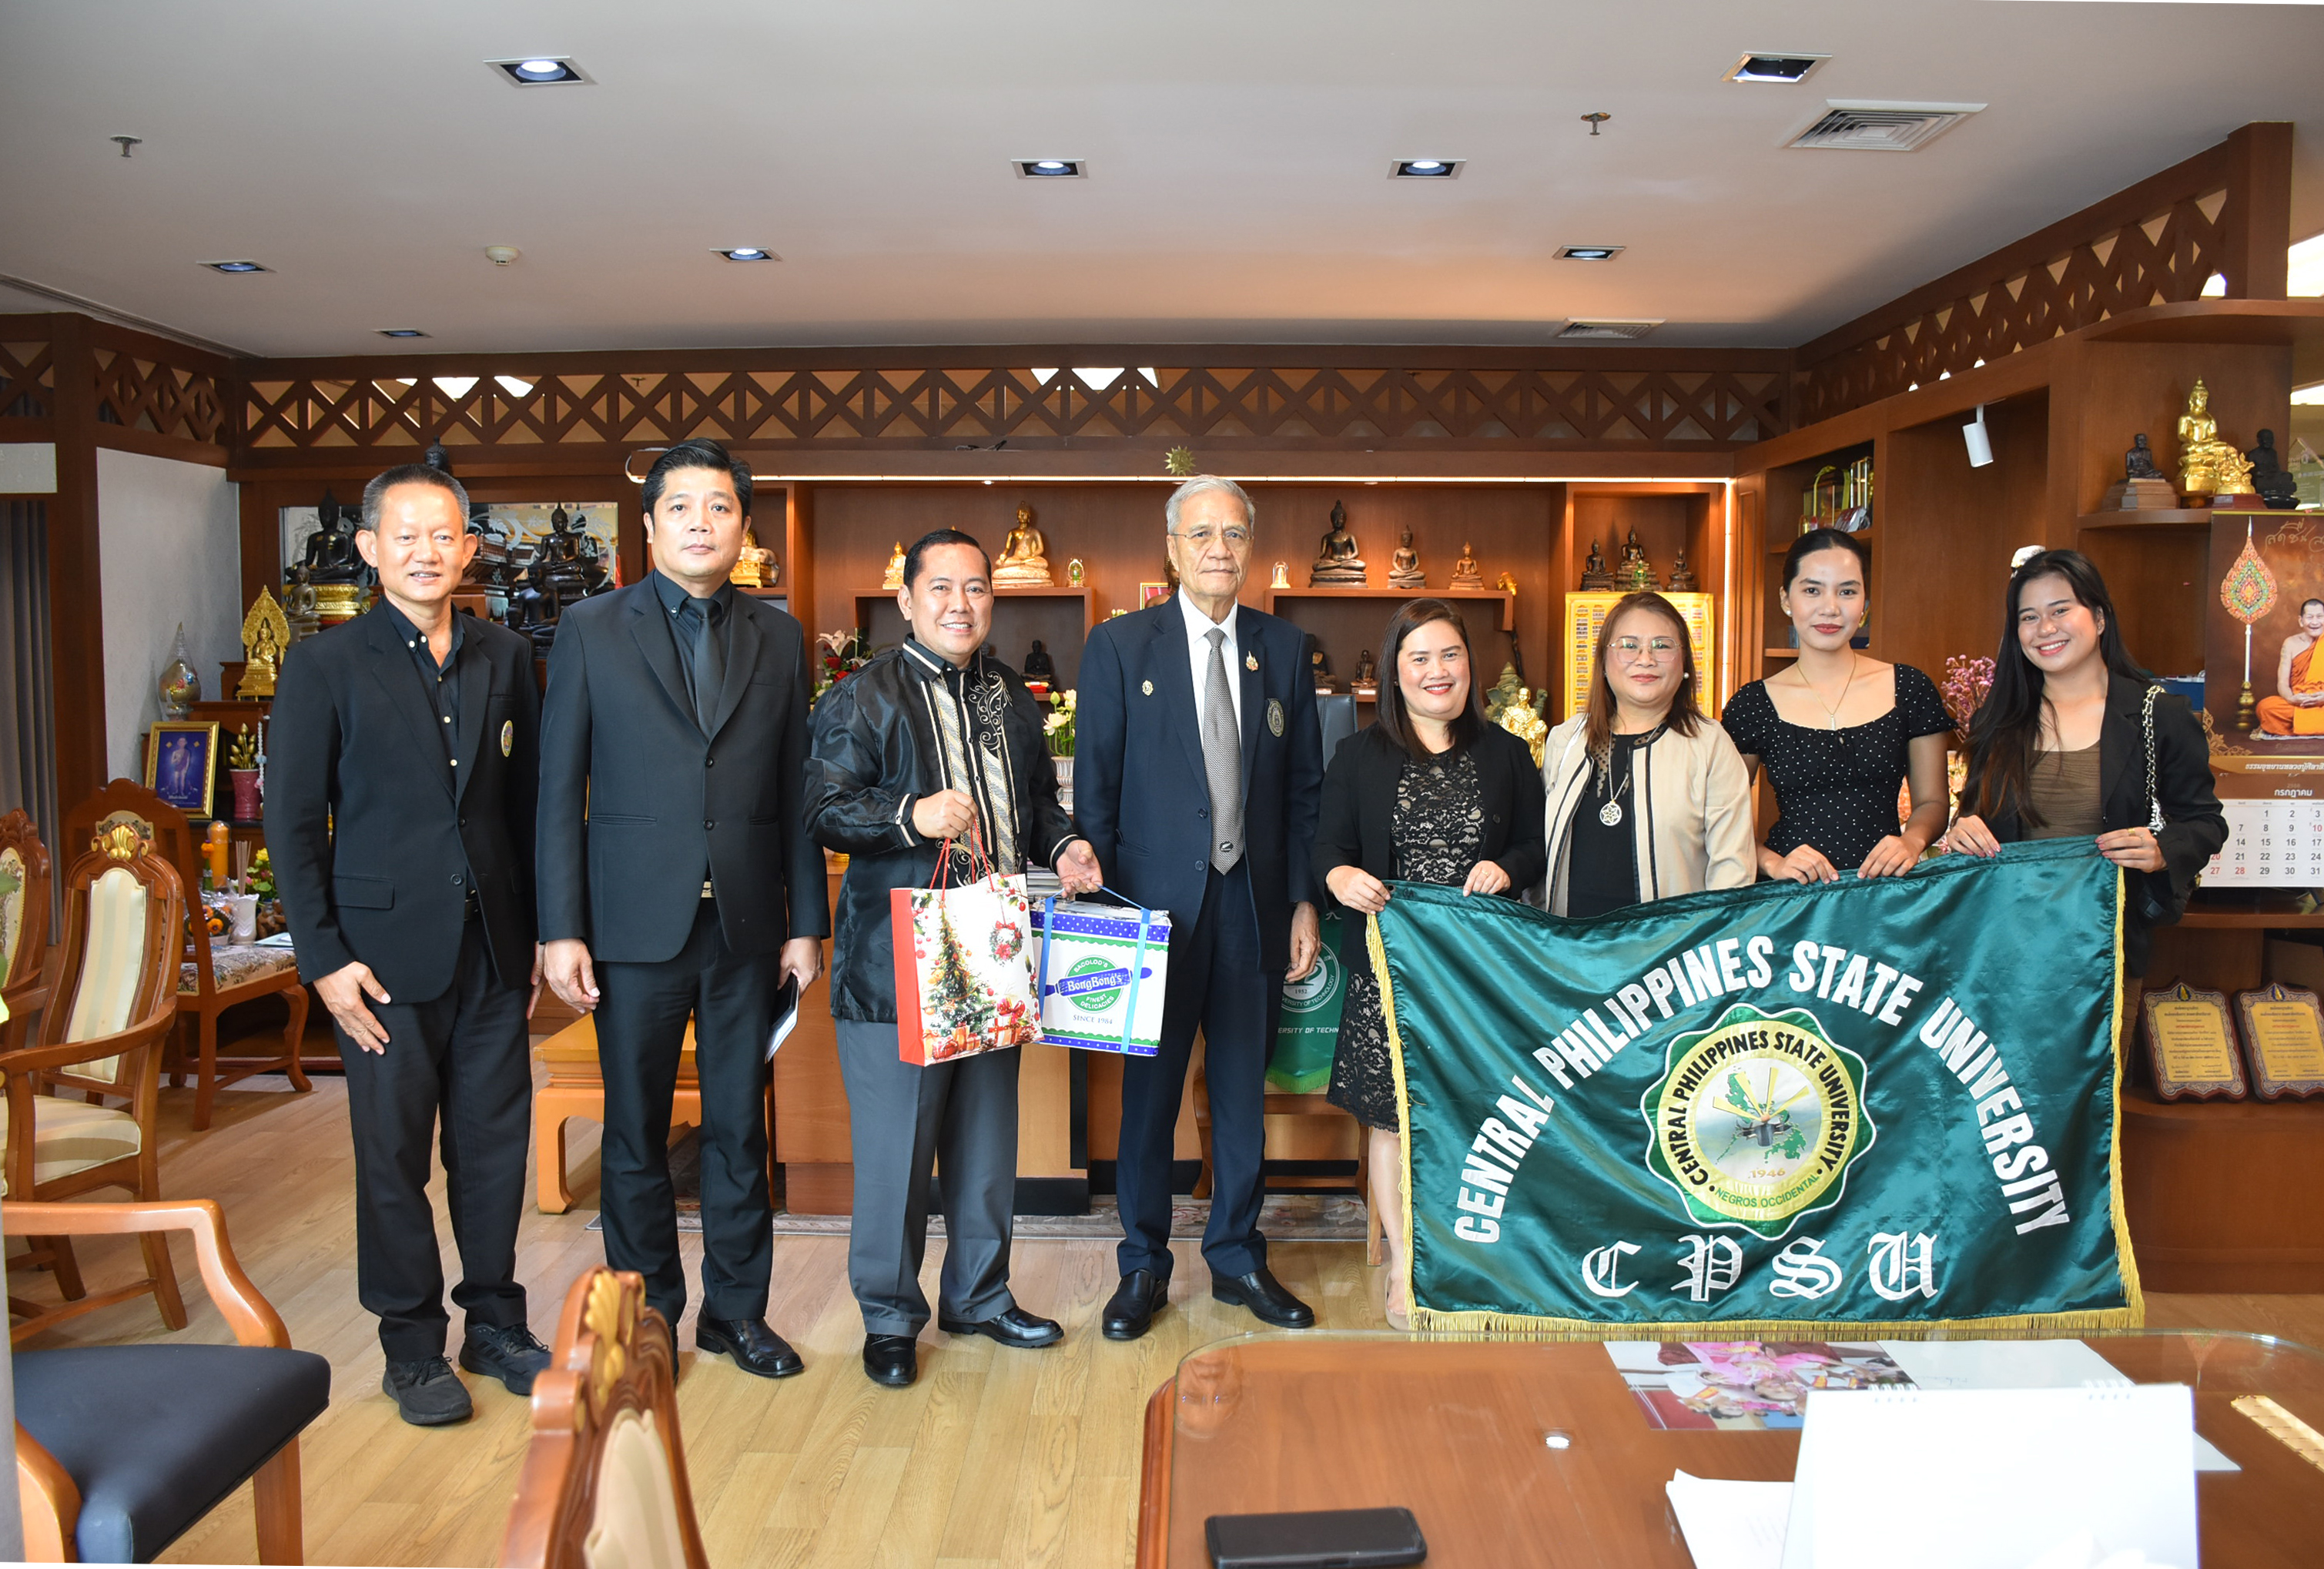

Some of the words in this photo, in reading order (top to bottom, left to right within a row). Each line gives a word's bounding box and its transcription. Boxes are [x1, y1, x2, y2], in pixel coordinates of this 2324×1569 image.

[2274, 789, 2312, 798] กรกฎาคม
[1073, 959, 1108, 973] BACOLOD'S
[1067, 973, 1123, 992] BongBong's
[1311, 975, 1335, 1004] TECHNOLOGY
[1080, 995, 1115, 1009] DELICACIES
[1086, 993, 1107, 1003] FINEST
[1073, 1014, 1094, 1022] SINCE
[1773, 1032, 1827, 1069] STATE
[1673, 1030, 1769, 1102] PHILIPPINES
[1454, 1075, 1554, 1243] CENTRAL
[1532, 935, 1773, 1089] PHILIPPINES
[1789, 940, 1924, 1026] STATE
[1919, 996, 2070, 1236] UNIVERSITY
[1819, 1064, 1850, 1173] UNIVERSITY
[1667, 1106, 1709, 1186] CENTRAL
[1750, 1167, 1786, 1178] 1946
[1715, 1187, 1758, 1208] NEGROS
[1760, 1175, 1820, 1208] OCCIDENTAL
